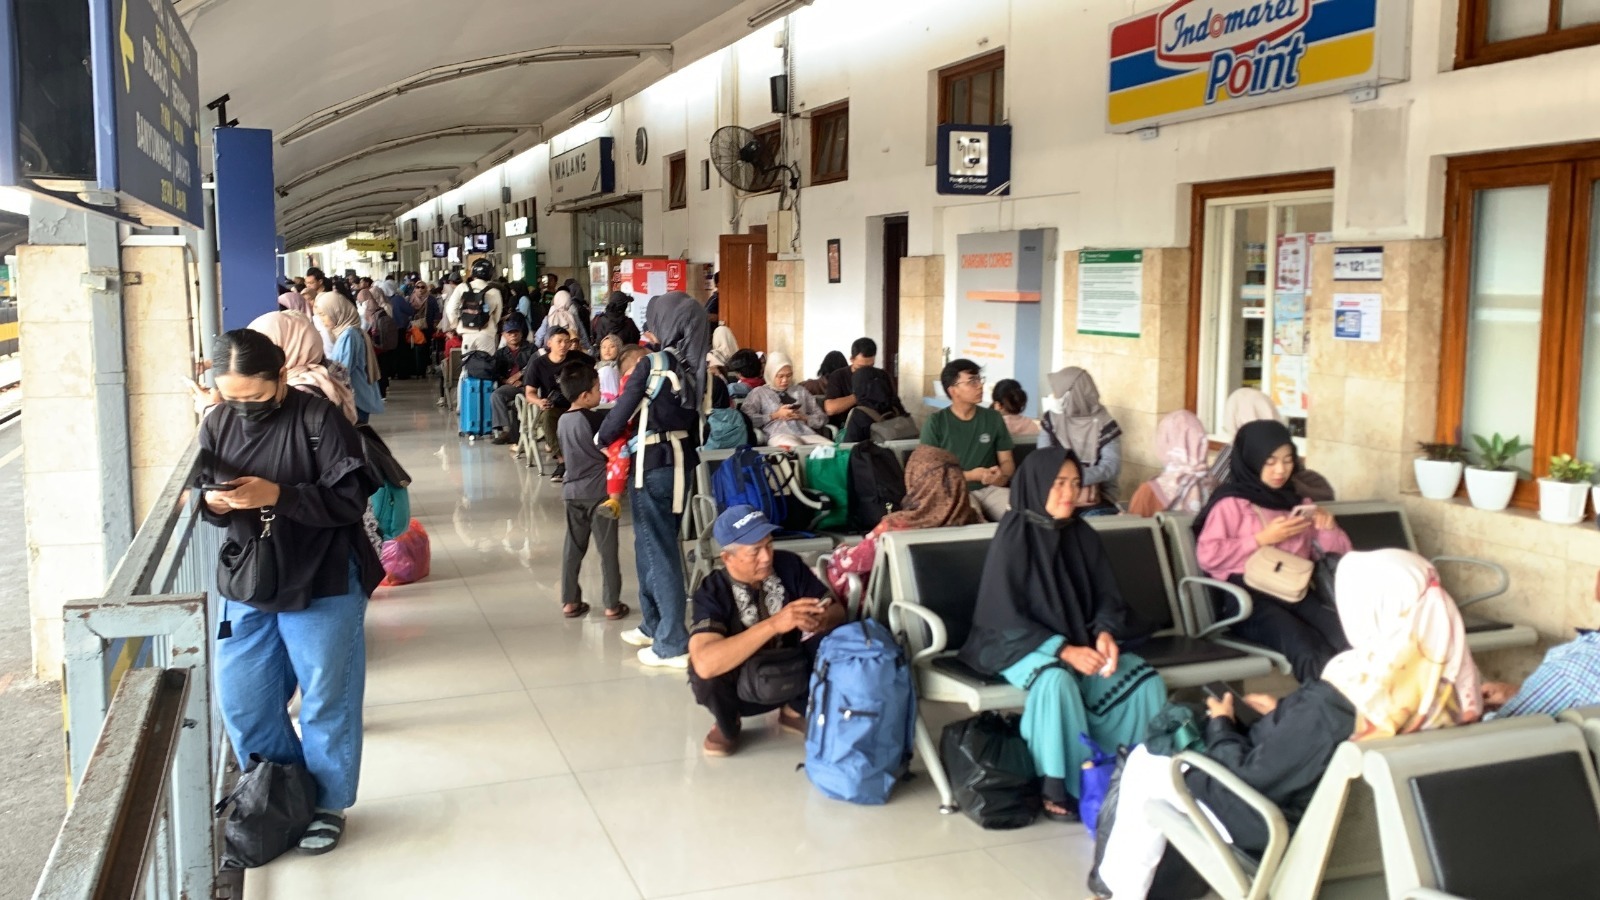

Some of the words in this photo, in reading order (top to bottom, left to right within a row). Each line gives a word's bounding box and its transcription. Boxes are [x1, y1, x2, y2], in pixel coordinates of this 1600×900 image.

[1205, 33, 1305, 103] Point
[555, 152, 586, 180] MALANG
[1349, 260, 1364, 272] 121
